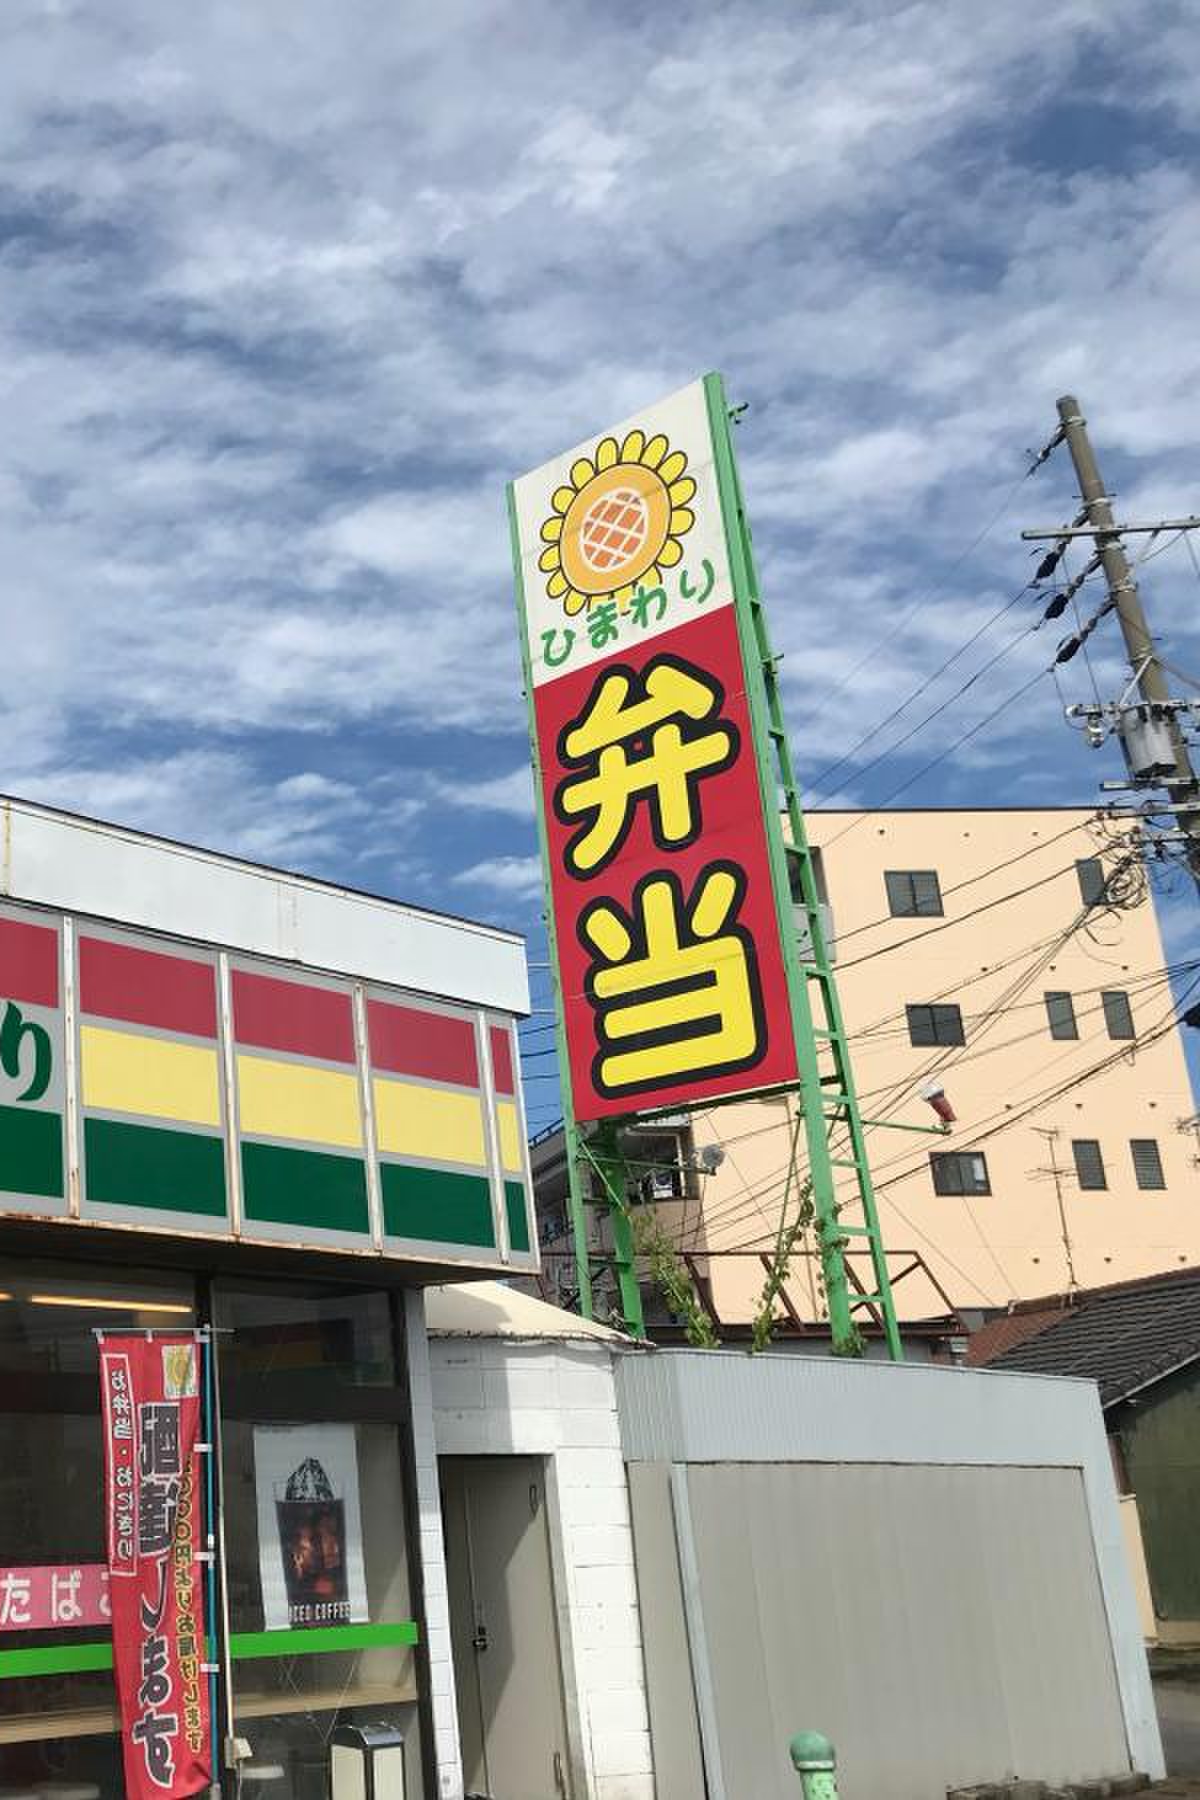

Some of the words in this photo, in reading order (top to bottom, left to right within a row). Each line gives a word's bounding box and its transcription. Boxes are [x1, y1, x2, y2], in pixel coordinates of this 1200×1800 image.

[540, 559, 716, 668] ひまわり
[558, 655, 766, 1097] 弁当
